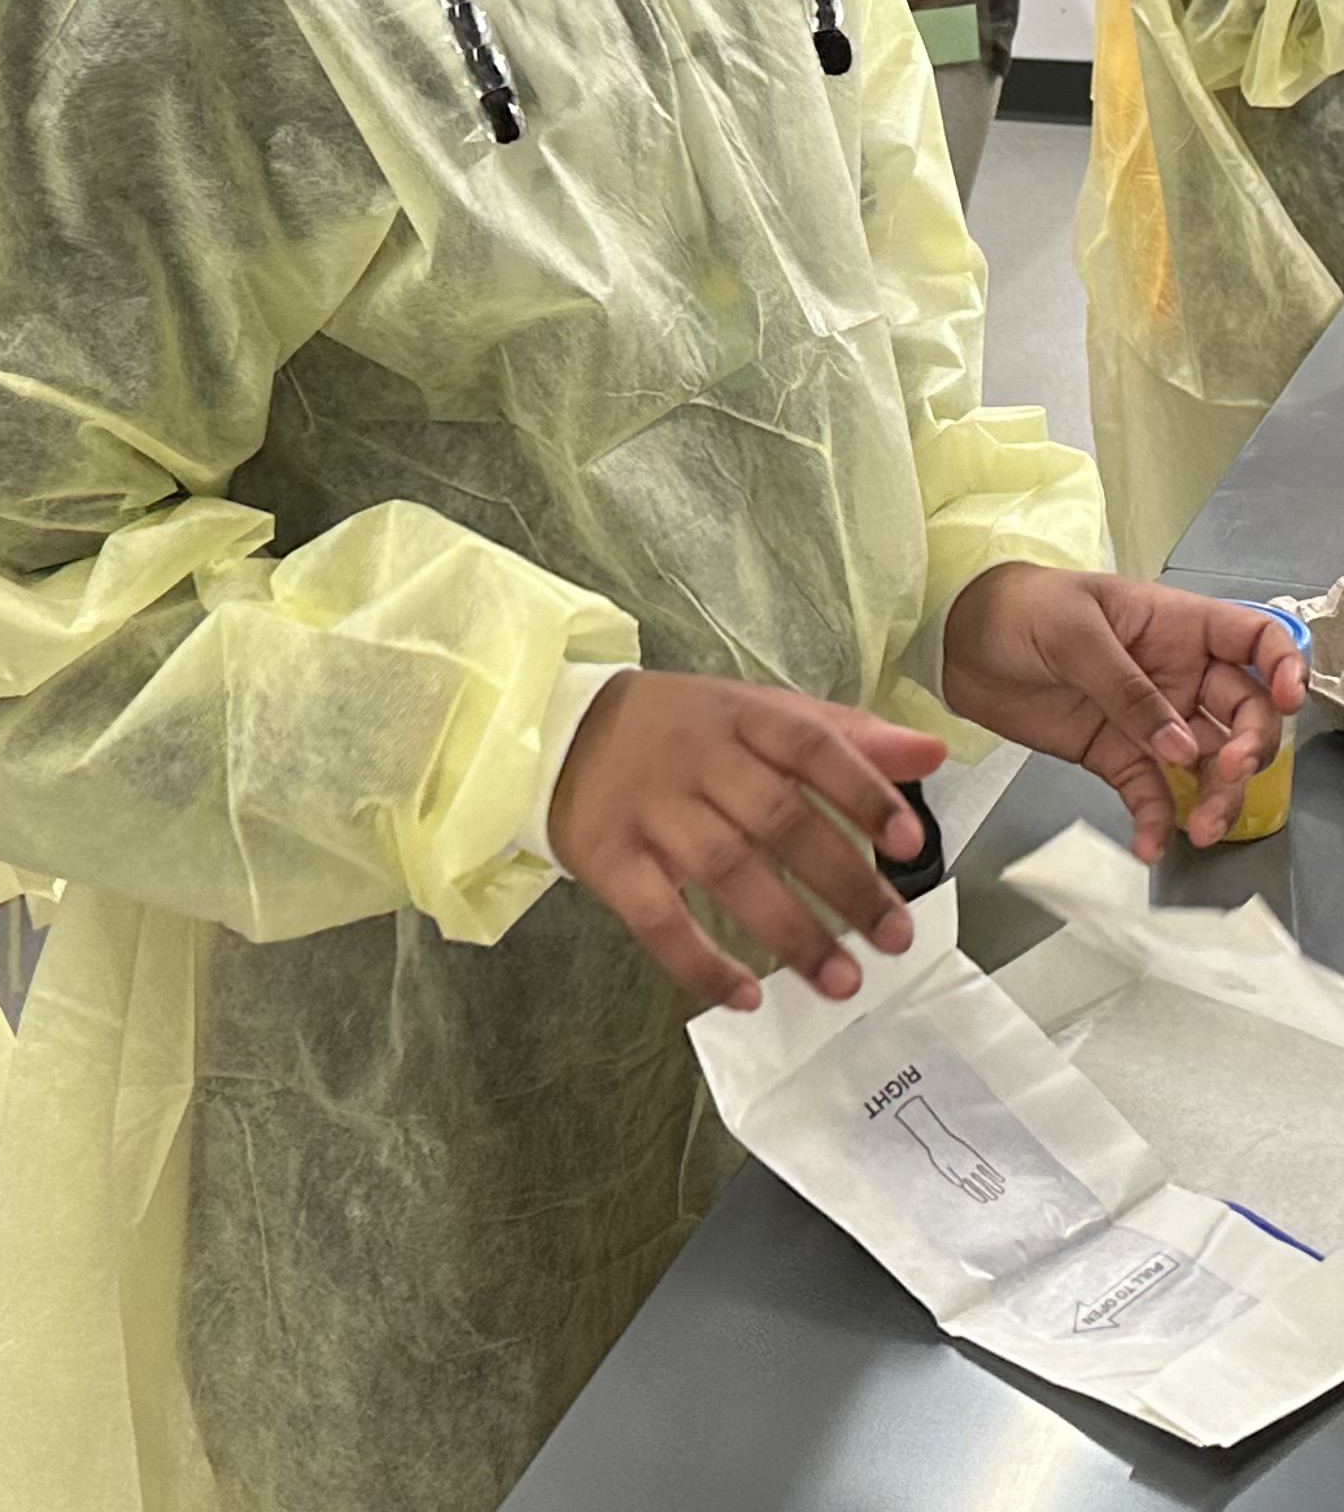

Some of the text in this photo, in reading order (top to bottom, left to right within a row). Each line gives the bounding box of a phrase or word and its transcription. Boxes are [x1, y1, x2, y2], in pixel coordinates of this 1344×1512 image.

[863, 1064, 922, 1121] RIGHT
[1081, 1261, 1164, 1325] PULL TO OPEN
